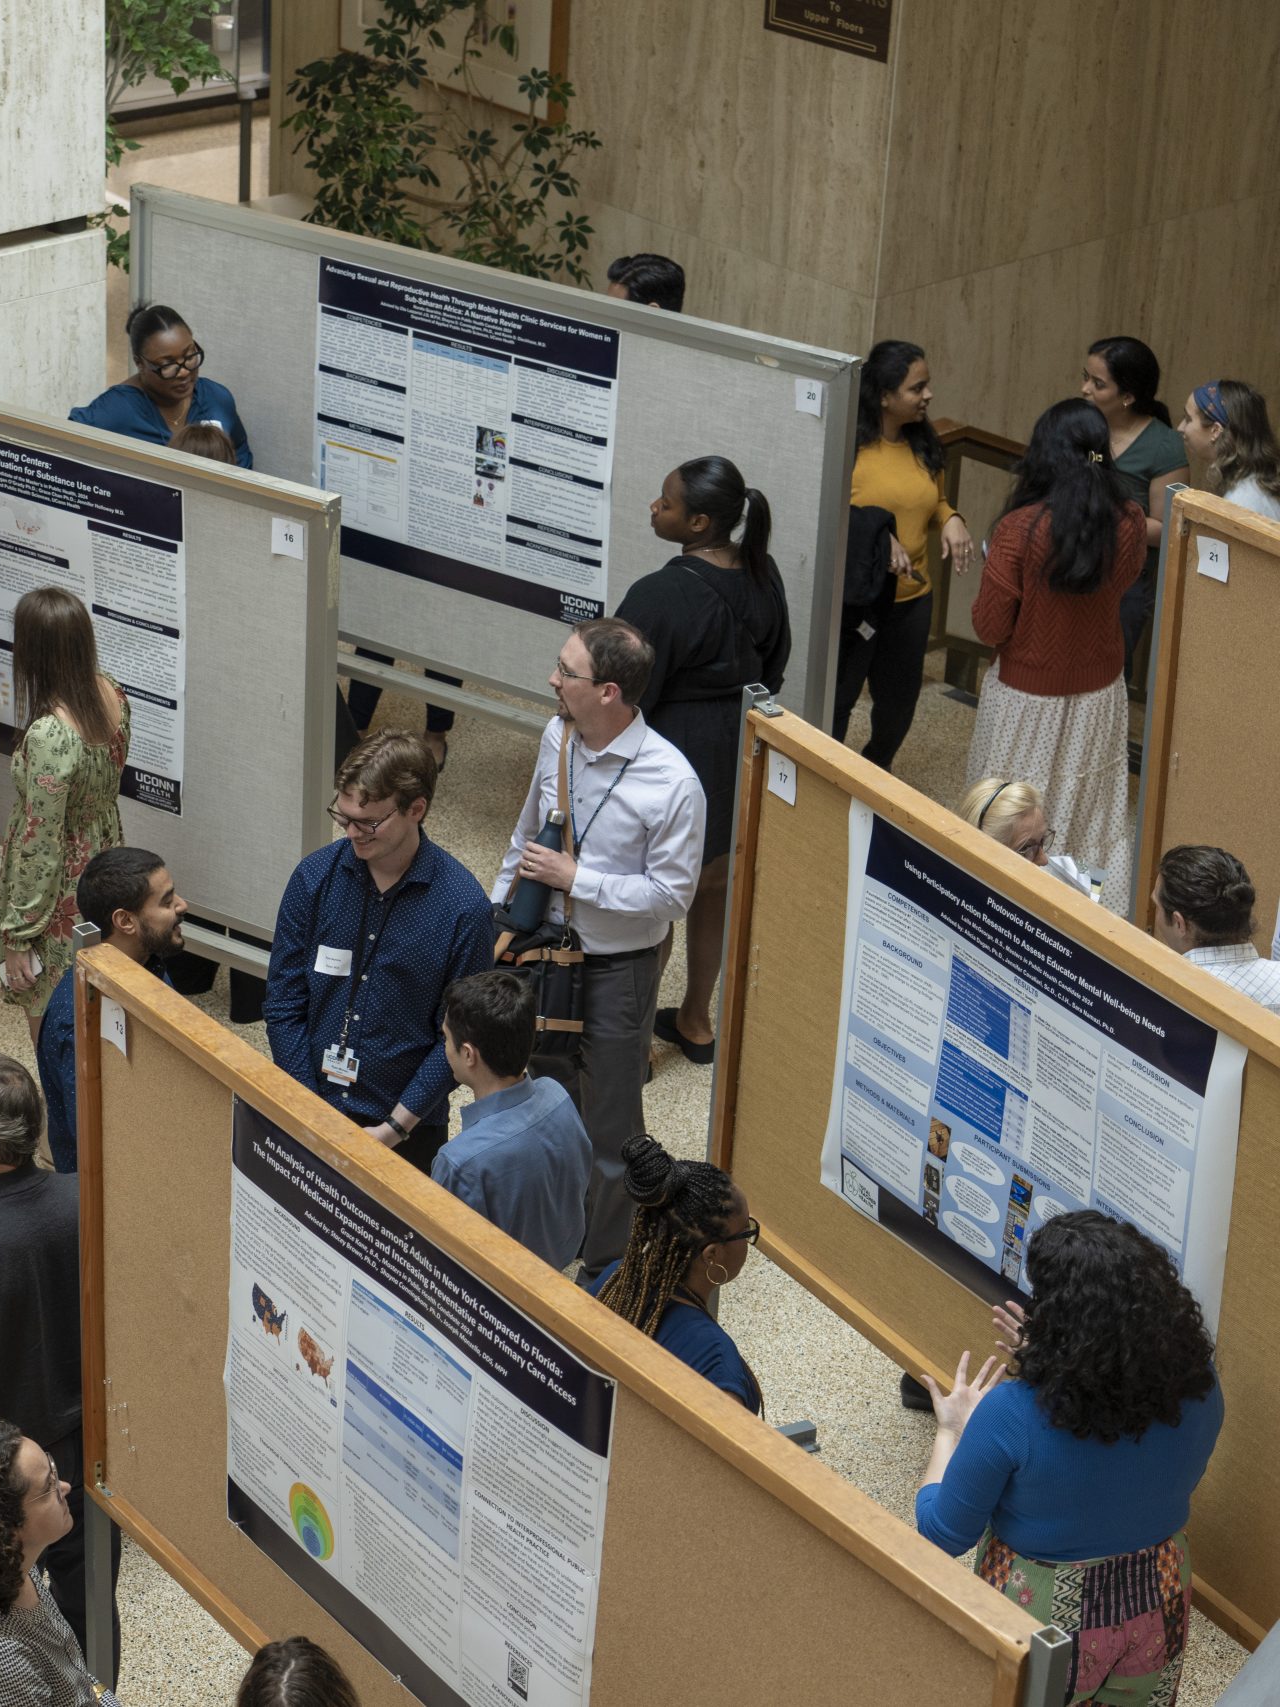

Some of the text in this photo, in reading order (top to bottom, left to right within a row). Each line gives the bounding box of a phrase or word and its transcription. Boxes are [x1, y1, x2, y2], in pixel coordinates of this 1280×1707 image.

[829, 1, 840, 12] To
[804, 10, 864, 34] Upper Floors
[325, 264, 355, 279] Advancing
[357, 272, 376, 284] Sexual
[378, 277, 389, 287] and
[390, 281, 428, 298] Reproductive
[430, 291, 450, 302] Health
[451, 296, 476, 310] Through
[478, 302, 498, 314] Mobile
[499, 308, 518, 319] Health
[520, 313, 538, 324] Clinic
[539, 318, 566, 331] Services
[568, 325, 578, 334] for
[578, 327, 602, 340] Women
[444, 304, 464, 315] Africa:
[470, 311, 498, 324] Narrative
[500, 318, 522, 330] Review
[807, 391, 816, 400] 20
[20, 453, 52, 470] Centers:
[24, 465, 34, 476] for
[36, 469, 74, 487] Substance
[76, 480, 91, 492] Use
[92, 485, 111, 498] Care
[284, 533, 294, 543] 16
[1209, 552, 1219, 563] 21
[560, 594, 598, 613] UCONN
[564, 605, 594, 619] HEALTH
[135, 771, 174, 792] UCONN
[140, 784, 170, 798] HEALTH
[779, 772, 788, 784] 17
[887, 891, 929, 923] COMPETENCIES
[986, 896, 1072, 958] Photovoice for Educators:
[882, 938, 922, 969] BACKGROUND
[904, 860, 921, 879] Using
[922, 872, 960, 906] Participatory
[960, 898, 980, 919] Action
[982, 912, 1011, 939] Research
[1021, 938, 1045, 961] Assess
[1046, 955, 1076, 982] Educator
[1078, 975, 1101, 998] Mental
[1103, 991, 1140, 1024] Well-being
[1141, 1015, 1165, 1038] Needs
[1013, 974, 1038, 998] RESULTS
[873, 1036, 905, 1063] OBJECTIVES
[1132, 1057, 1169, 1088] DISCUSSION
[1124, 1113, 1164, 1146] CONCLUSION
[974, 1133, 1050, 1191] PARTICIPANT SUBMISSIONS
[265, 1136, 274, 1150] An
[276, 1144, 304, 1174] Analysis
[314, 1174, 338, 1199] Health
[340, 1194, 379, 1231] Outcomes
[380, 1225, 408, 1253] among
[409, 1247, 431, 1272] Adults
[442, 1274, 458, 1295] New
[460, 1289, 478, 1310] York
[478, 1304, 519, 1343] Compared
[520, 1337, 529, 1351] to
[530, 1345, 562, 1378] Florida:
[252, 1142, 265, 1158] The
[266, 1152, 291, 1179] Impact
[300, 1180, 334, 1213] Medicaid
[335, 1207, 373, 1243] Expansion
[375, 1237, 390, 1256] and
[392, 1251, 429, 1287] Increasing
[430, 1281, 476, 1326] Preventative
[477, 1320, 492, 1339] and
[494, 1333, 526, 1368] Primary
[527, 1360, 546, 1383] Care
[548, 1376, 576, 1407] Access
[421, 1289, 436, 1306] Health
[405, 1311, 424, 1330] RESULTS
[520, 1408, 549, 1433] DISCUSSION
[474, 1490, 506, 1516] CONNECTION
[515, 1518, 566, 1561] INTERPROFESSIONAL
[567, 1558, 585, 1575] PUBLIC
[506, 1523, 549, 1558] HEALTH PRACTICE
[507, 1602, 536, 1630] CONCLUSION
[505, 1640, 532, 1668] REFERENCES
